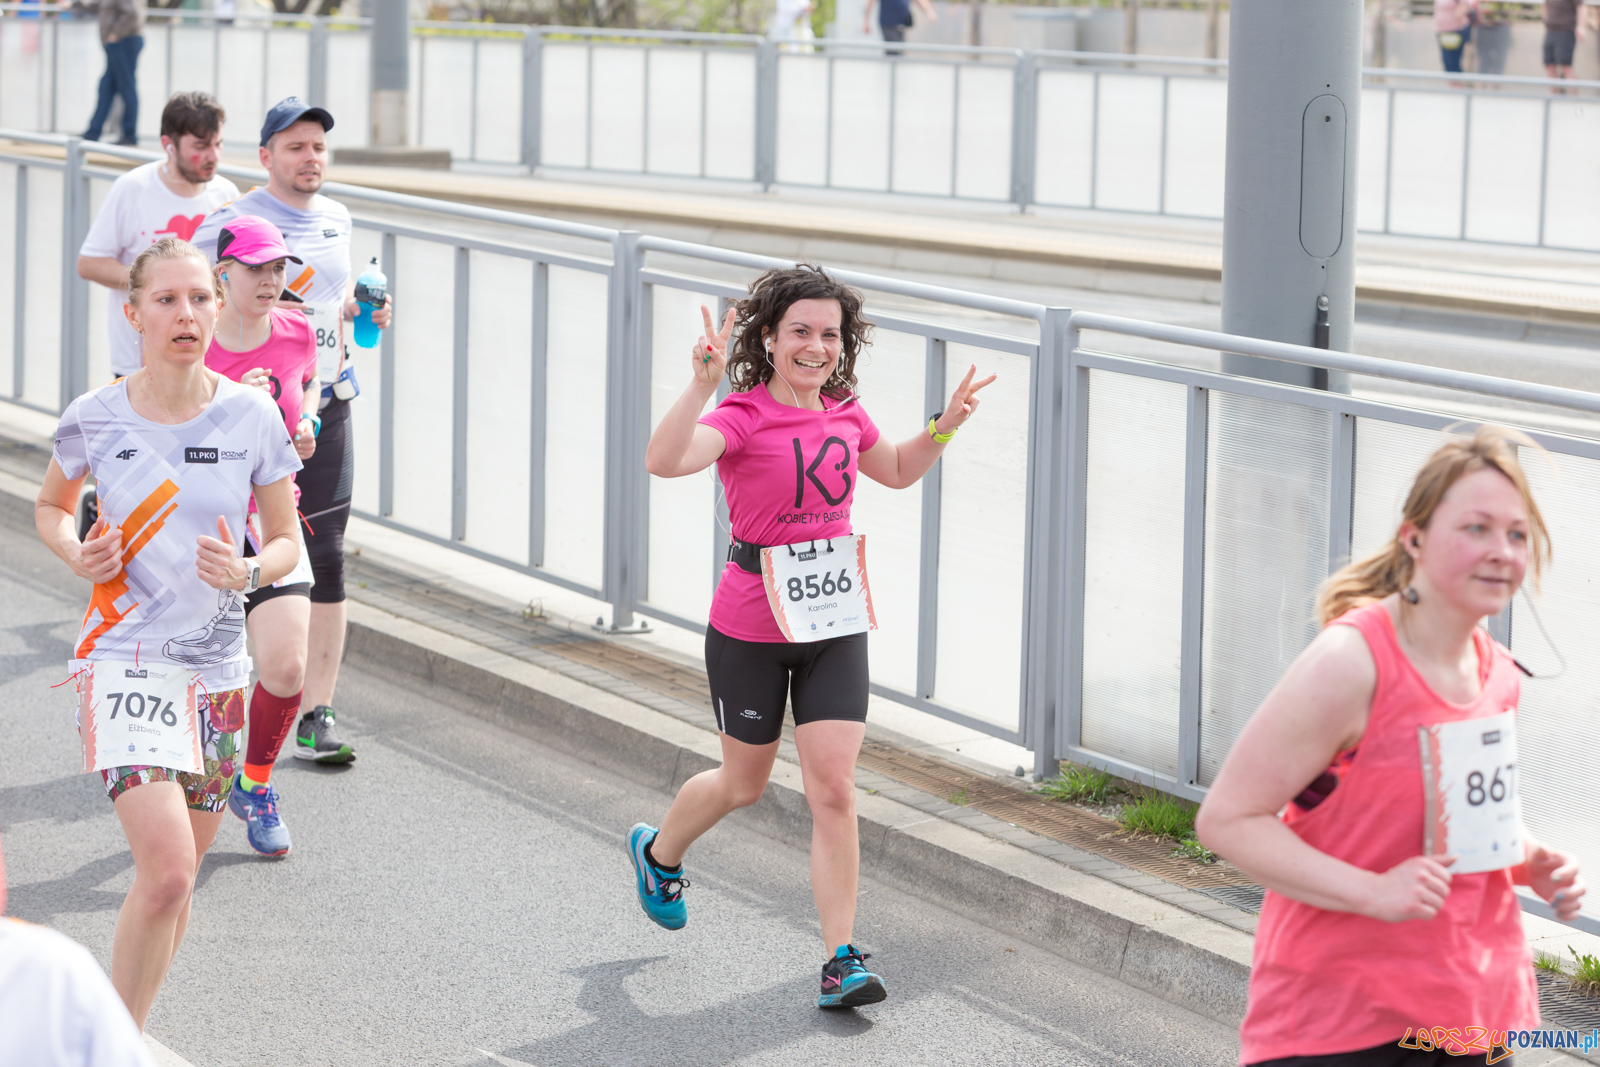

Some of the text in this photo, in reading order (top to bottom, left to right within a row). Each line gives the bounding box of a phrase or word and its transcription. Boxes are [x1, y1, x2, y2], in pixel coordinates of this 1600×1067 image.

[115, 449, 138, 460] 4F
[199, 451, 216, 460] PKO
[777, 512, 821, 525] KOBIETY
[787, 568, 852, 602] 8566
[807, 602, 838, 613] Karolina
[106, 691, 178, 728] 7076
[128, 723, 162, 737] Elżbieta
